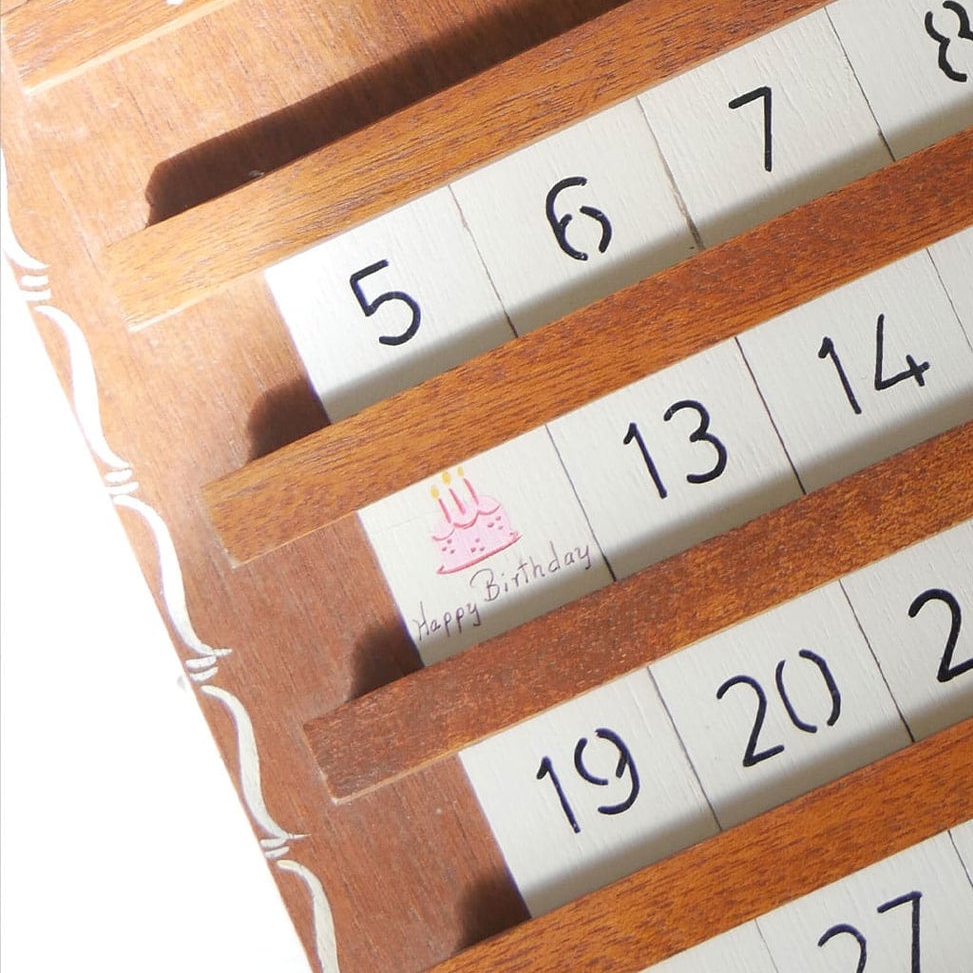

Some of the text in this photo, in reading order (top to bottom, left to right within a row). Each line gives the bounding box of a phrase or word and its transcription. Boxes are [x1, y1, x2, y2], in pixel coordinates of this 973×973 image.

[350, 259, 421, 346] 5
[545, 176, 612, 261] 6
[728, 86, 773, 173] 7
[623, 400, 728, 499] 13
[818, 314, 930, 415] 14
[412, 540, 592, 641] Happy Birthday
[536, 729, 640, 834] 19
[716, 649, 841, 768] 20
[817, 890, 922, 973] 27
